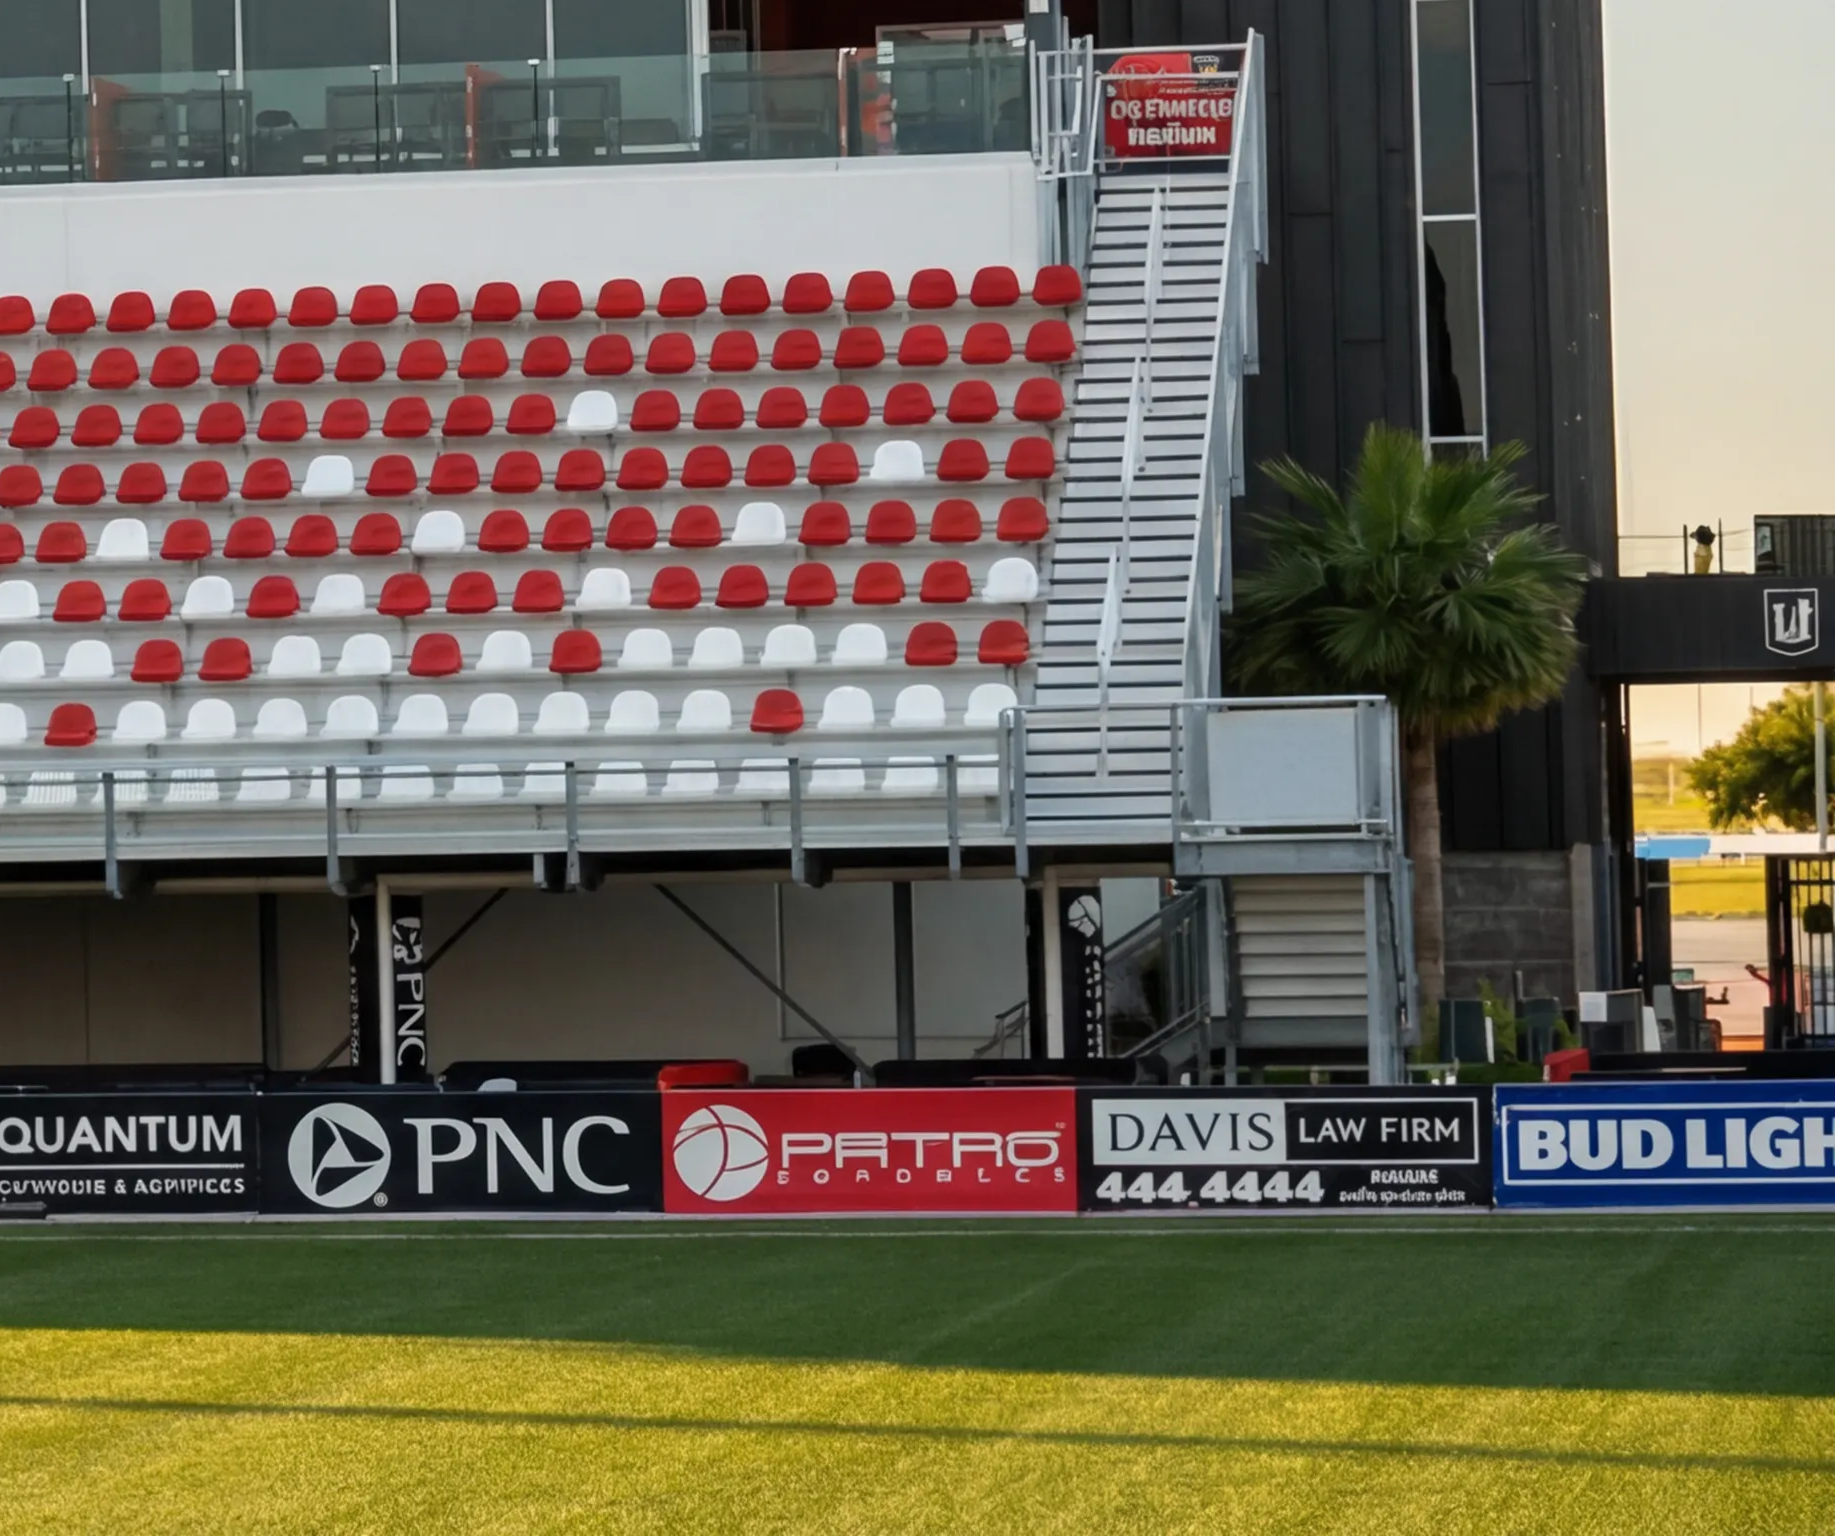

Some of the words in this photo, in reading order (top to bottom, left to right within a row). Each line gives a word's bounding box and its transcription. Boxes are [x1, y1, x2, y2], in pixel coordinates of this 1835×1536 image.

[396, 972, 426, 1066] PNC
[402, 1115, 630, 1194] PNC
[1108, 1112, 1274, 1152] DAVIS
[1299, 1117, 1368, 1144] LAW
[1380, 1116, 1460, 1144] FIRM
[1518, 1119, 1674, 1171] BUD
[1199, 1170, 1325, 1204] 4444
